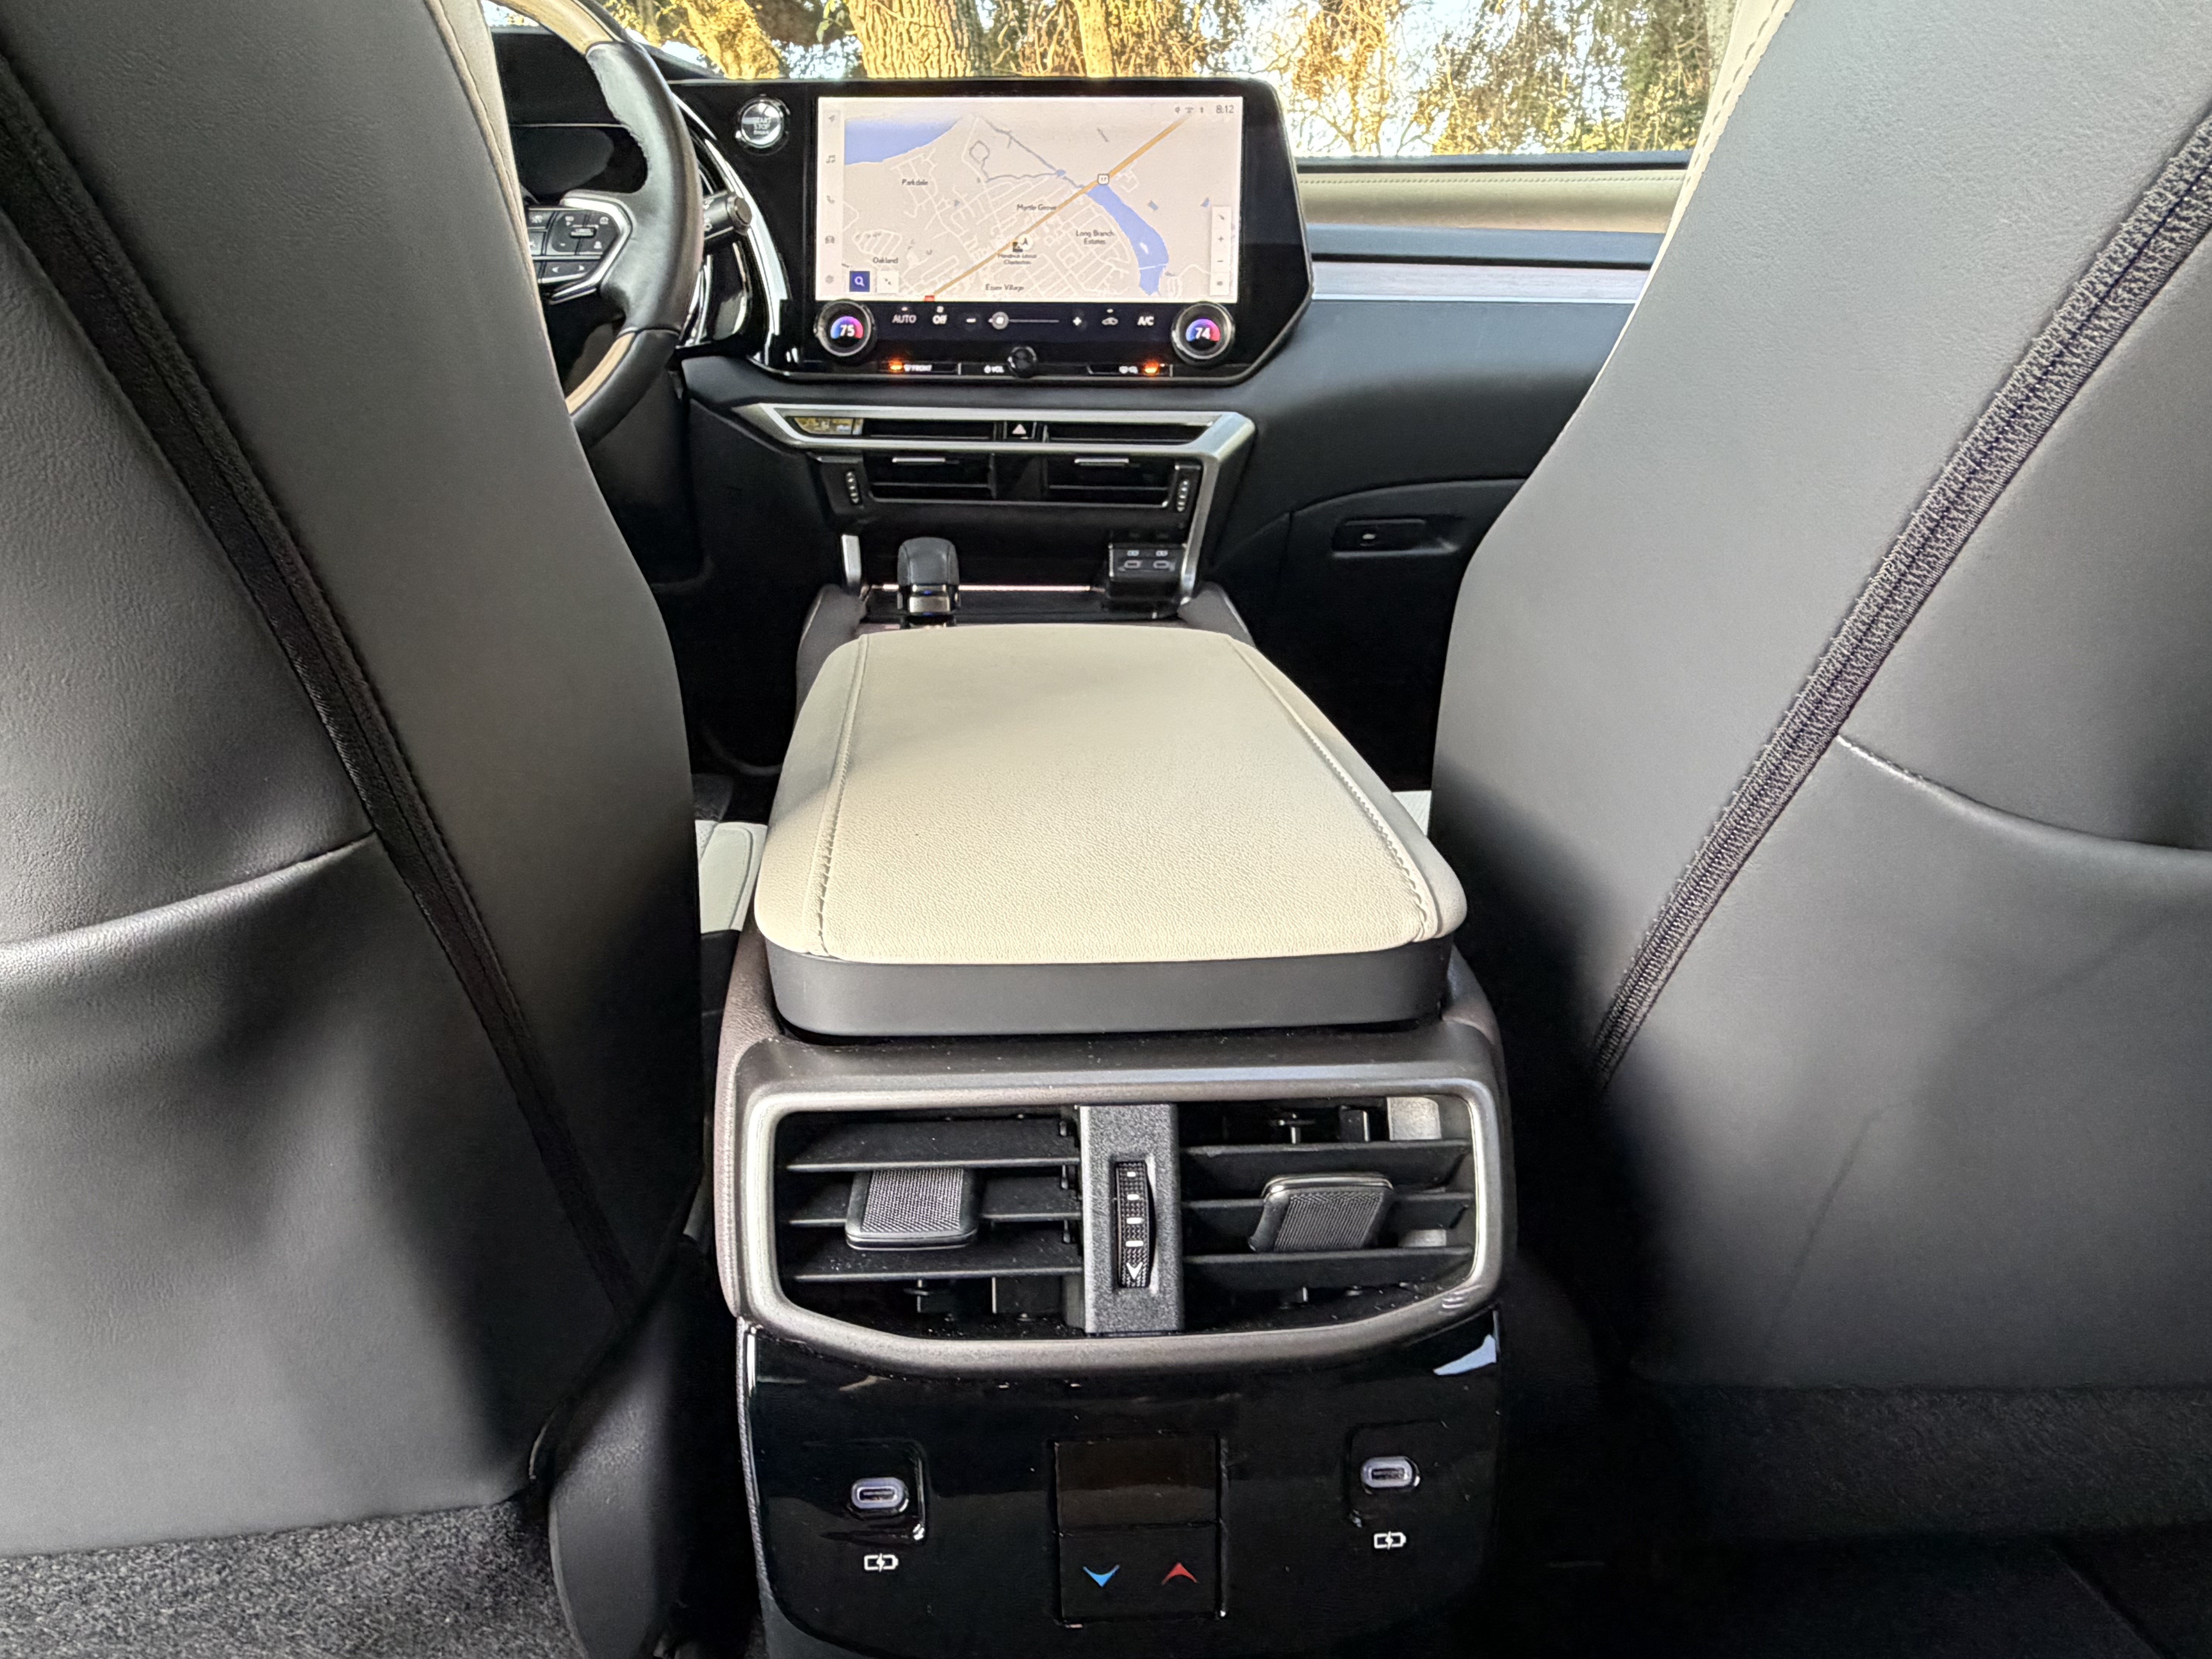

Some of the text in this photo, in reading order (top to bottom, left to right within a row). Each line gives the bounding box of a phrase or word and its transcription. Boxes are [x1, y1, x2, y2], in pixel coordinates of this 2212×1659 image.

[1216, 105, 1234, 114] 8:12
[891, 314, 917, 324] AUTO
[1137, 316, 1154, 326] A/C
[840, 325, 855, 337] 75
[1195, 327, 1211, 340] 74
